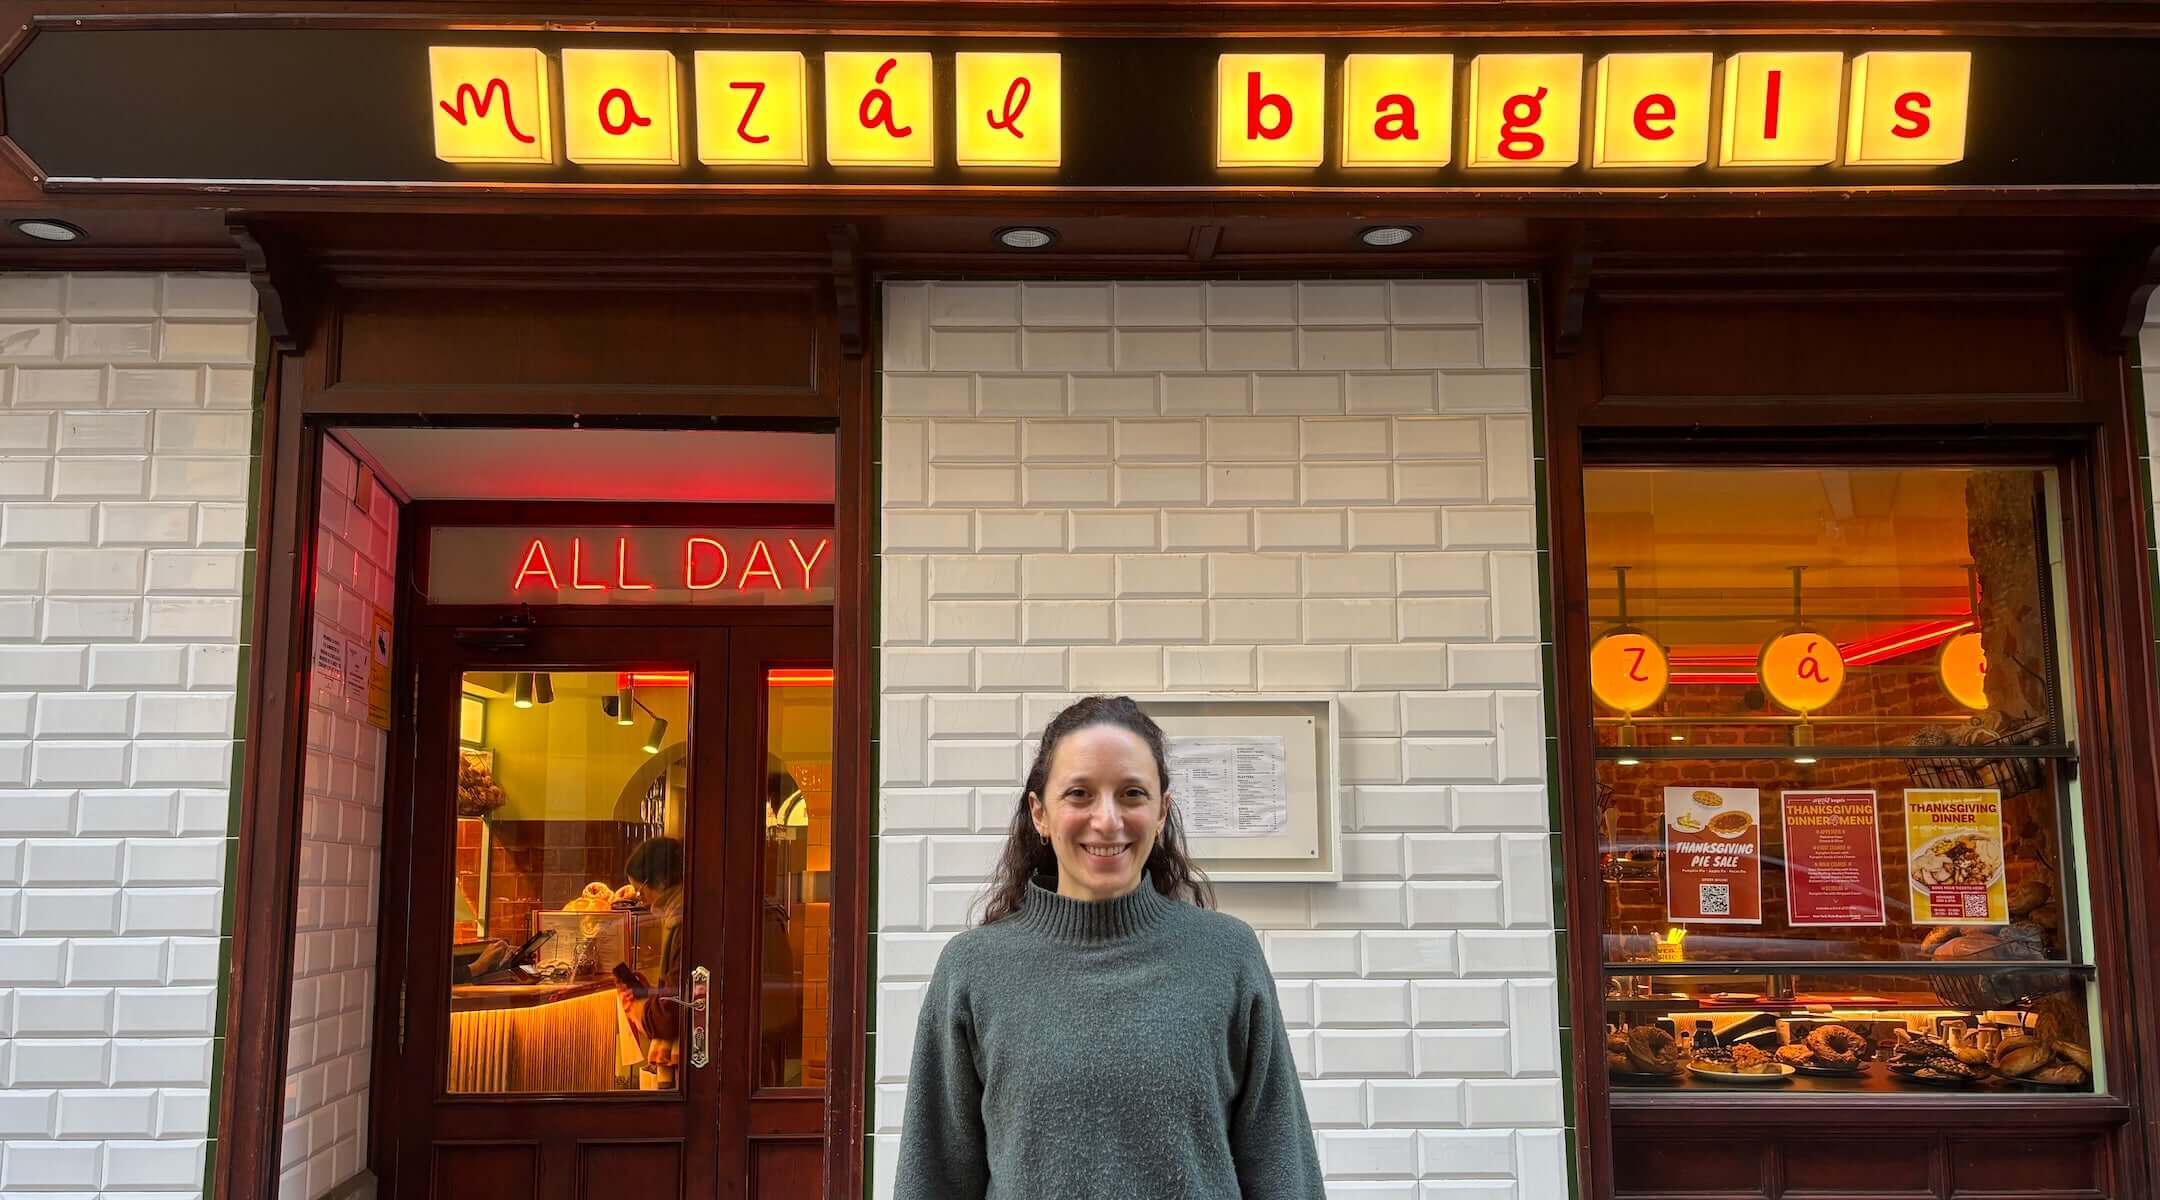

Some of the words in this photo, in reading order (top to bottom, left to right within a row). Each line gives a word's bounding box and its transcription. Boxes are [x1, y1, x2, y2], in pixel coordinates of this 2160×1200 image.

[440, 58, 1031, 144] mazál
[1247, 69, 1932, 161] bagels
[514, 537, 653, 590] ALL
[687, 537, 828, 590] DAY
[1786, 804, 1873, 815] THANKSGIVING
[1910, 803, 1997, 813] THANKSGIVING
[1787, 815, 1830, 826] DINNER
[1840, 815, 1873, 825] MENU
[1931, 813, 1976, 823] DINNER
[1675, 841, 1754, 855] THANKSGIVING
[1691, 855, 1711, 867] PIE
[1713, 855, 1739, 868] SALE
